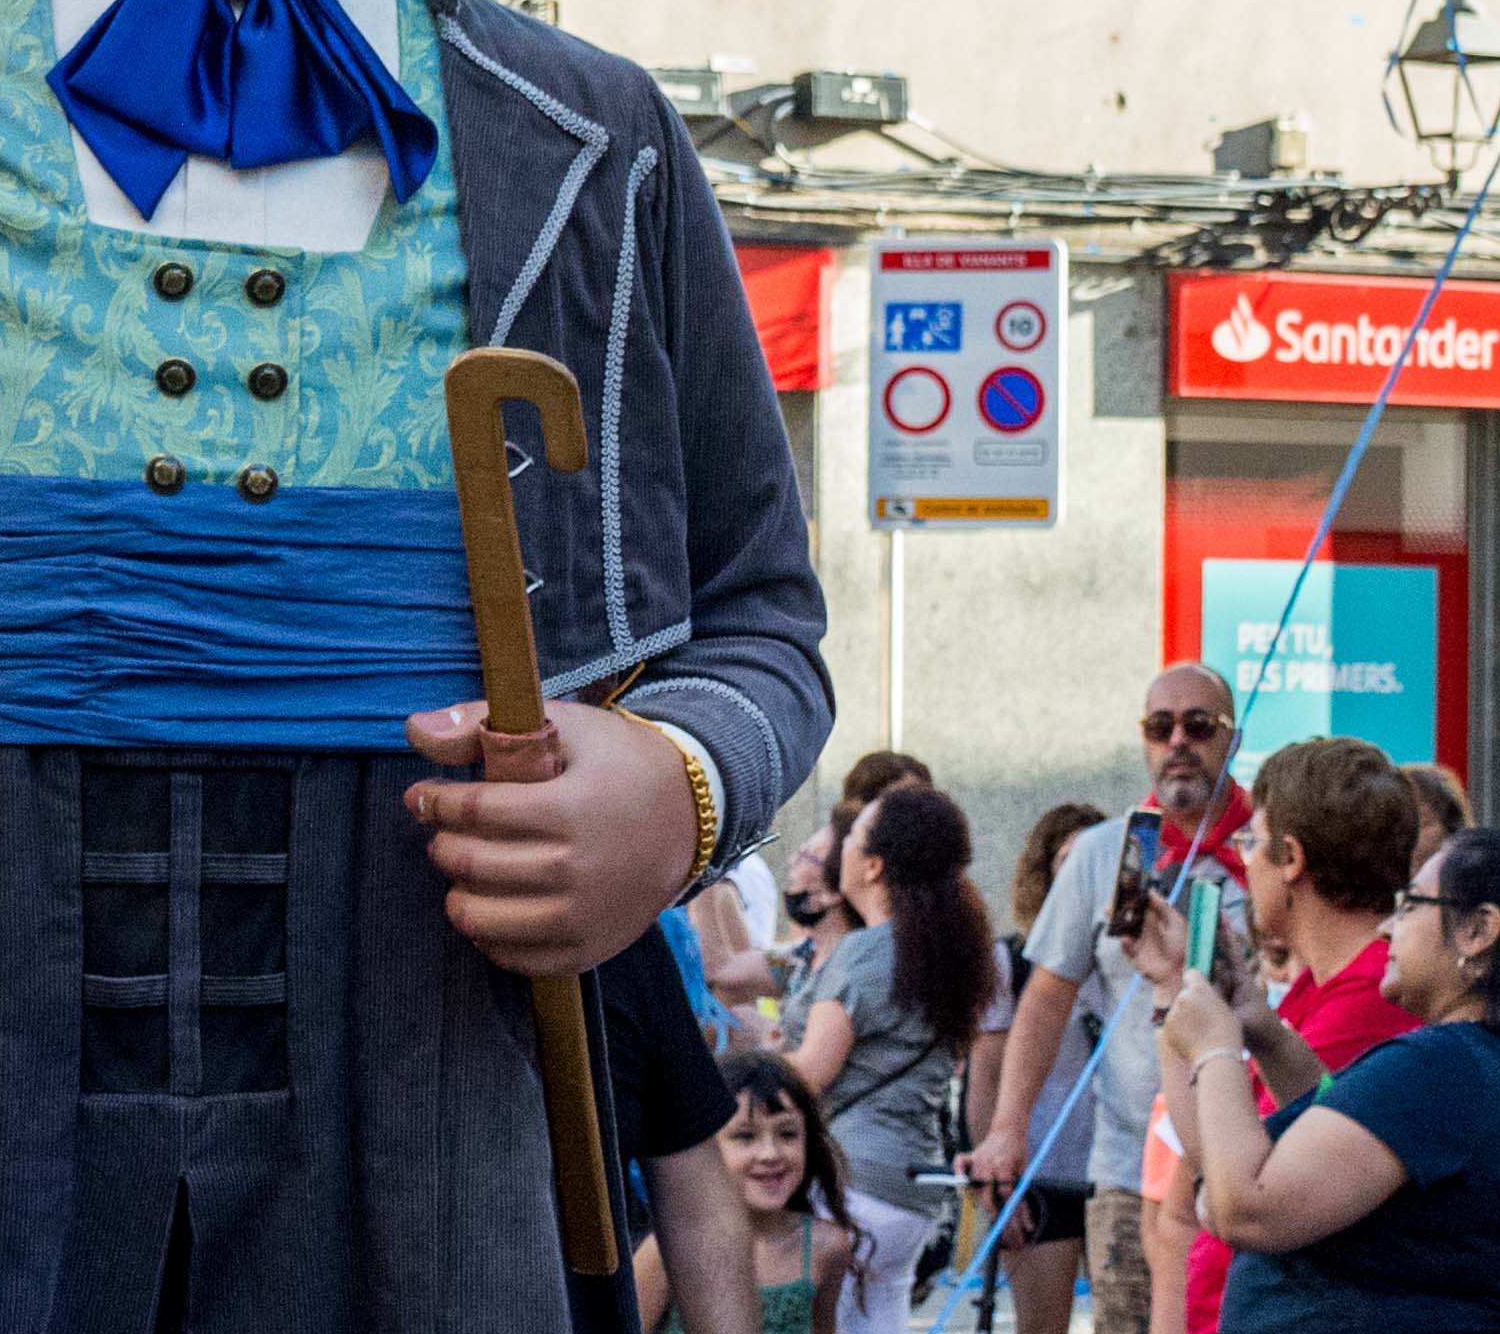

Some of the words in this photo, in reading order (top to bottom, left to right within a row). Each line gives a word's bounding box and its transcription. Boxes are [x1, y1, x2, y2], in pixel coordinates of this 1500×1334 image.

[1008, 318, 1032, 337] 10
[1275, 309, 1500, 370] Santander
[1236, 621, 1288, 654] PER
[1291, 622, 1334, 658] TU,
[1236, 661, 1282, 692] ELS
